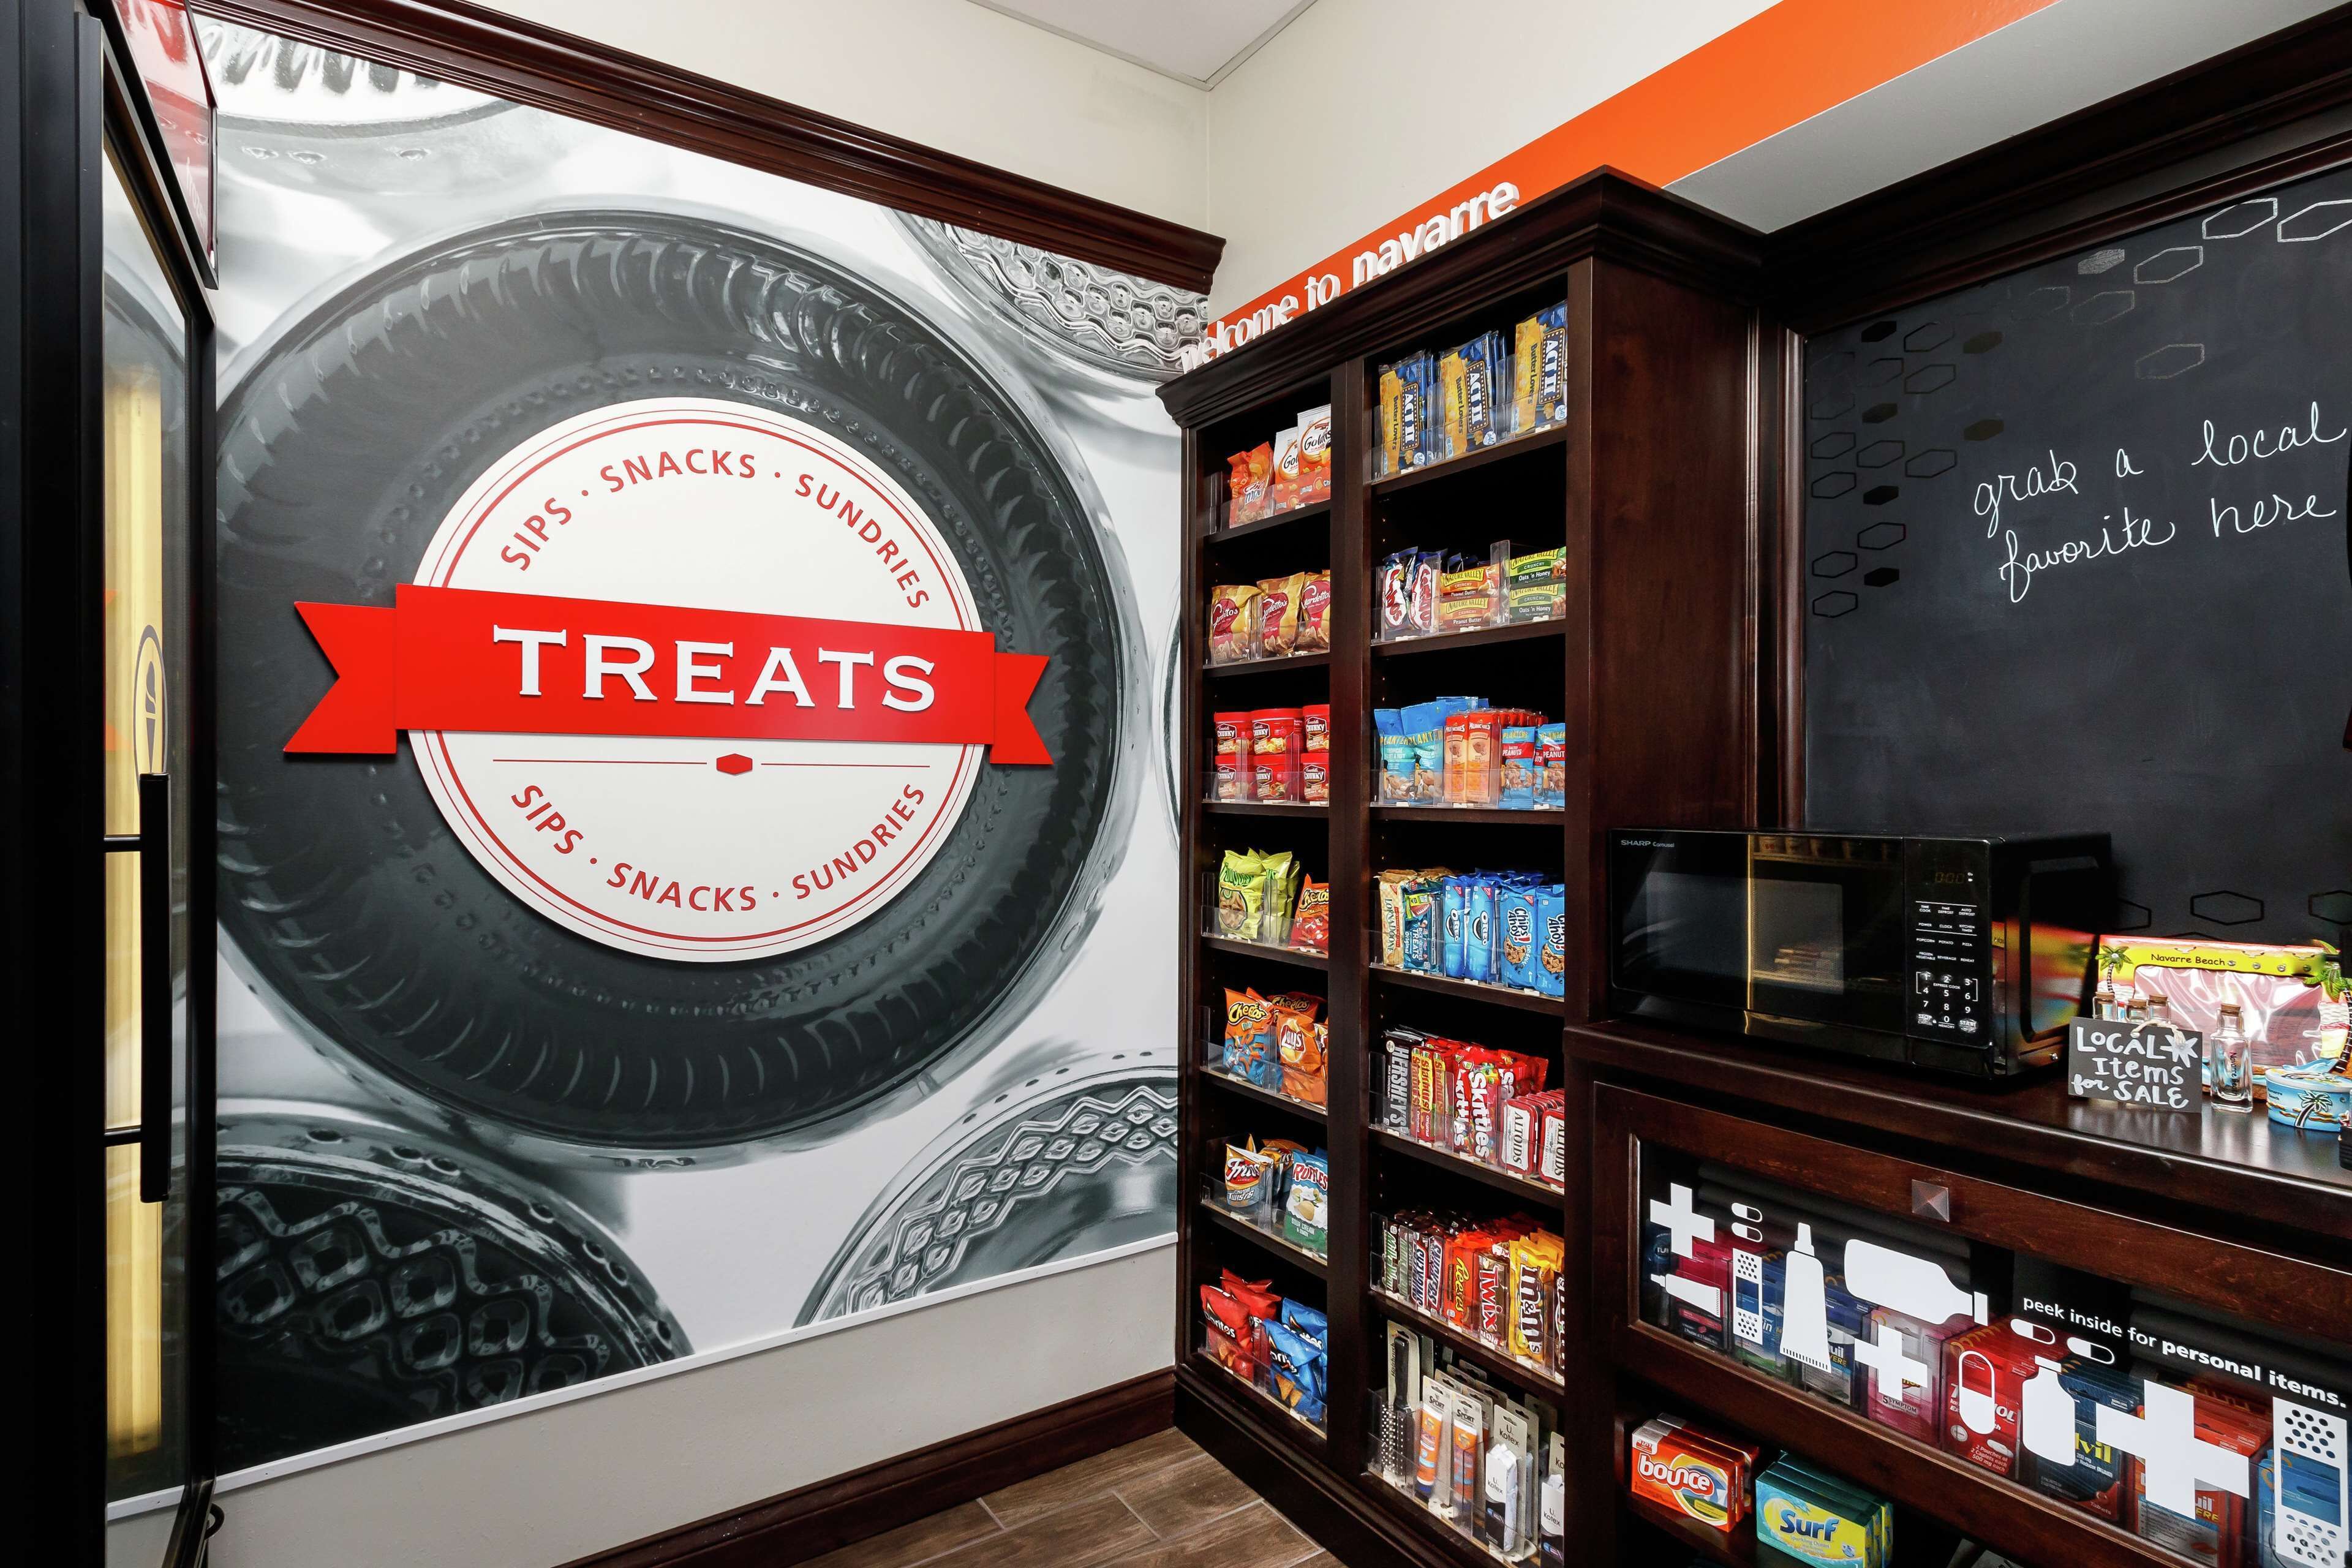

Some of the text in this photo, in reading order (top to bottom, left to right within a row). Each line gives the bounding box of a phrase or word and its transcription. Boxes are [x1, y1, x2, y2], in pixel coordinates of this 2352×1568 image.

[1304, 273, 1341, 312] to
[1352, 181, 1520, 287] navarre
[1545, 341, 1558, 373] ACT
[1470, 373, 1482, 405] ACT
[1528, 372, 1537, 405] Lovers
[1404, 394, 1415, 422] ACT
[1974, 401, 2347, 538] grab a local
[500, 448, 930, 609] SIPS SNACKS SUNDRIES
[1998, 494, 2337, 603] favorite here
[1446, 568, 1483, 583] NATURE VALLEY
[1449, 597, 1487, 611] NATURE VALLEY
[493, 624, 936, 713] TREATS
[510, 783, 925, 912] SIPS SNACKS SUNDRIES
[1385, 898, 1396, 953] LORNA DOONE
[1450, 908, 1460, 942] OREO
[1480, 911, 1489, 946] OREO
[1515, 908, 1529, 936] Chips
[2150, 953, 2226, 967] Navarre Beach
[1228, 1002, 1267, 1023] Cheetos
[2076, 1027, 2166, 1060] LOCAL
[1390, 1046, 1409, 1127] HERSHEY'S
[2092, 1058, 2184, 1085] Items
[2071, 1074, 2189, 1109] for SALE
[1468, 1071, 1493, 1158] Skittles
[1512, 1111, 1524, 1164] ALTOIDS
[1226, 1158, 1261, 1181] Fritos
[1293, 1163, 1328, 1191] RUFFLES
[1203, 1310, 1236, 1338] Doritos
[2022, 1296, 2348, 1408] peek inside for personal items.
[1429, 1396, 1445, 1409] SPORT
[1456, 1409, 1474, 1423] SPORT
[1882, 1395, 1888, 1404] 5
[1888, 1397, 1917, 1413] SYMPTOM
[1506, 1424, 1512, 1433] U
[1975, 1449, 1994, 1463] Caplets
[1994, 1459, 2007, 1468] each
[1980, 1446, 2001, 1458] Pouches
[1993, 1463, 2005, 1472] each
[1638, 1453, 1712, 1492] bounce
[1779, 1509, 1840, 1542] Surf
